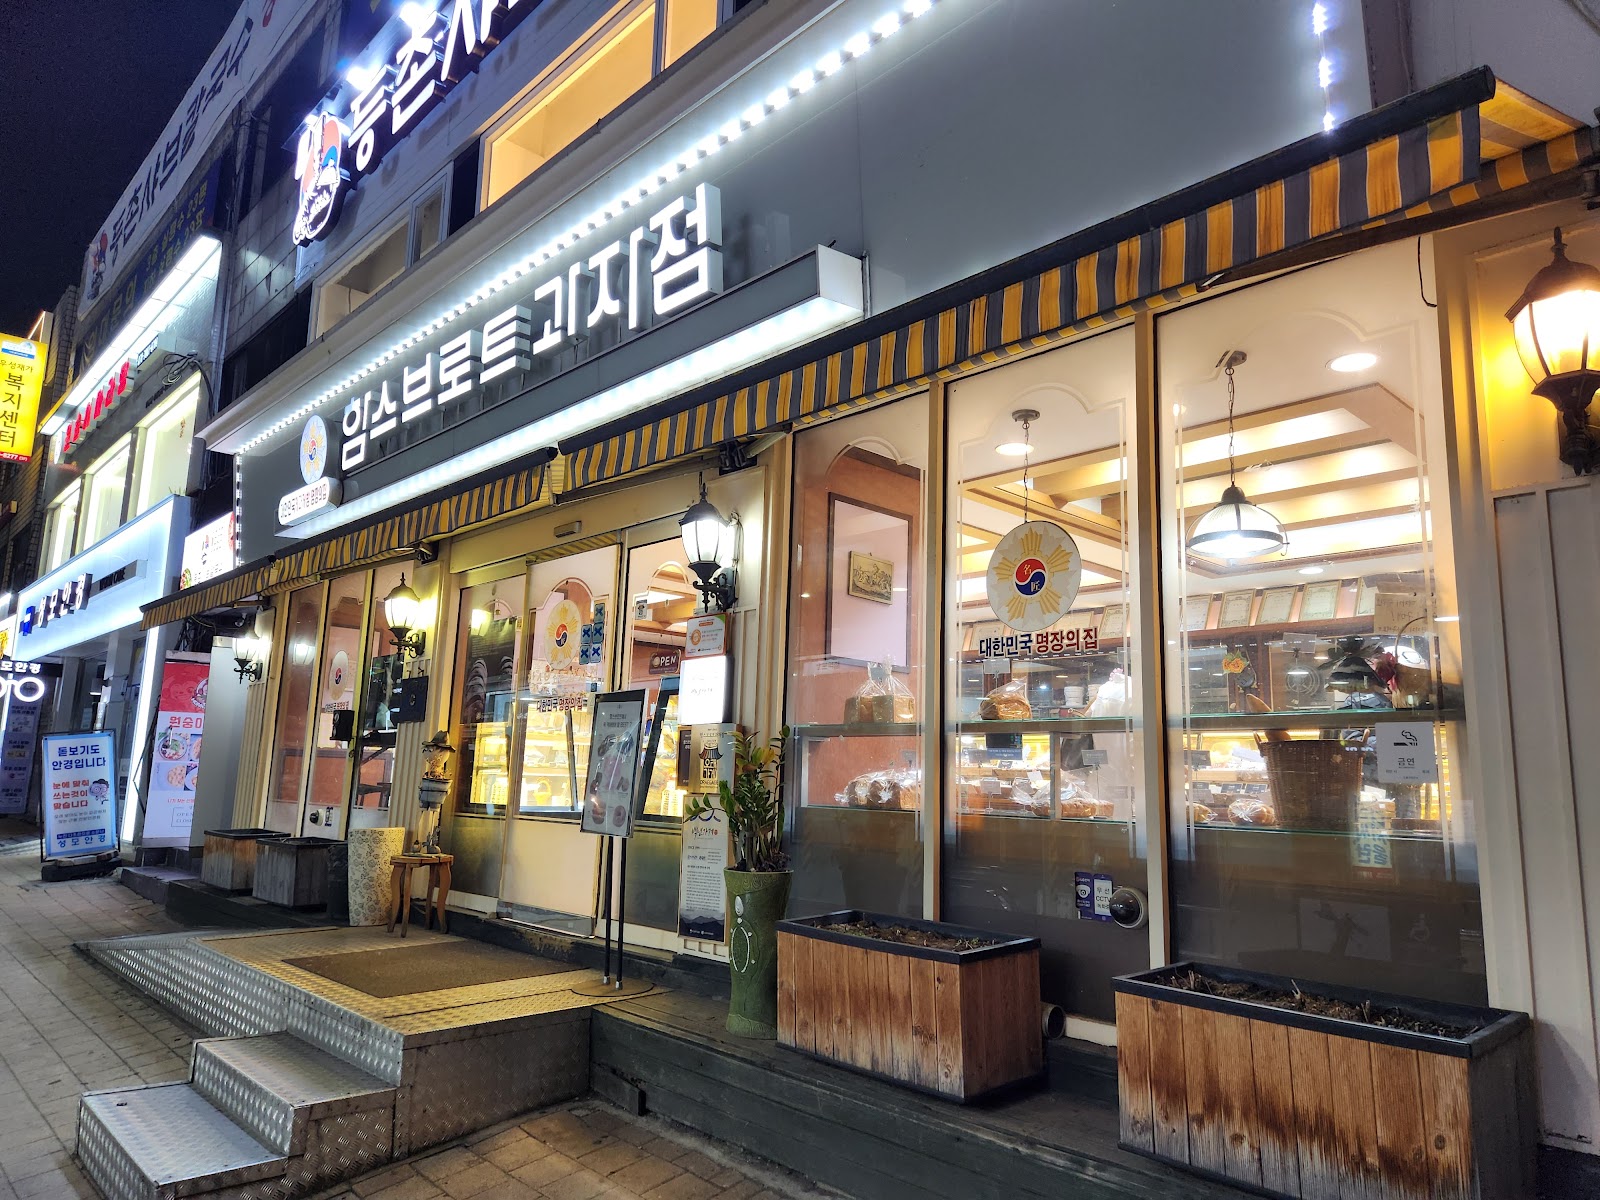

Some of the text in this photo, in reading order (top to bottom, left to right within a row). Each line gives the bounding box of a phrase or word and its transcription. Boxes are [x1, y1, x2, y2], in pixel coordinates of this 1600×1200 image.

[979, 626, 1099, 657] 대한민국 명장의집
[58, 744, 101, 757] 돋보기도
[51, 757, 106, 771] 안경입니다
[1397, 757, 1416, 767] 금연
